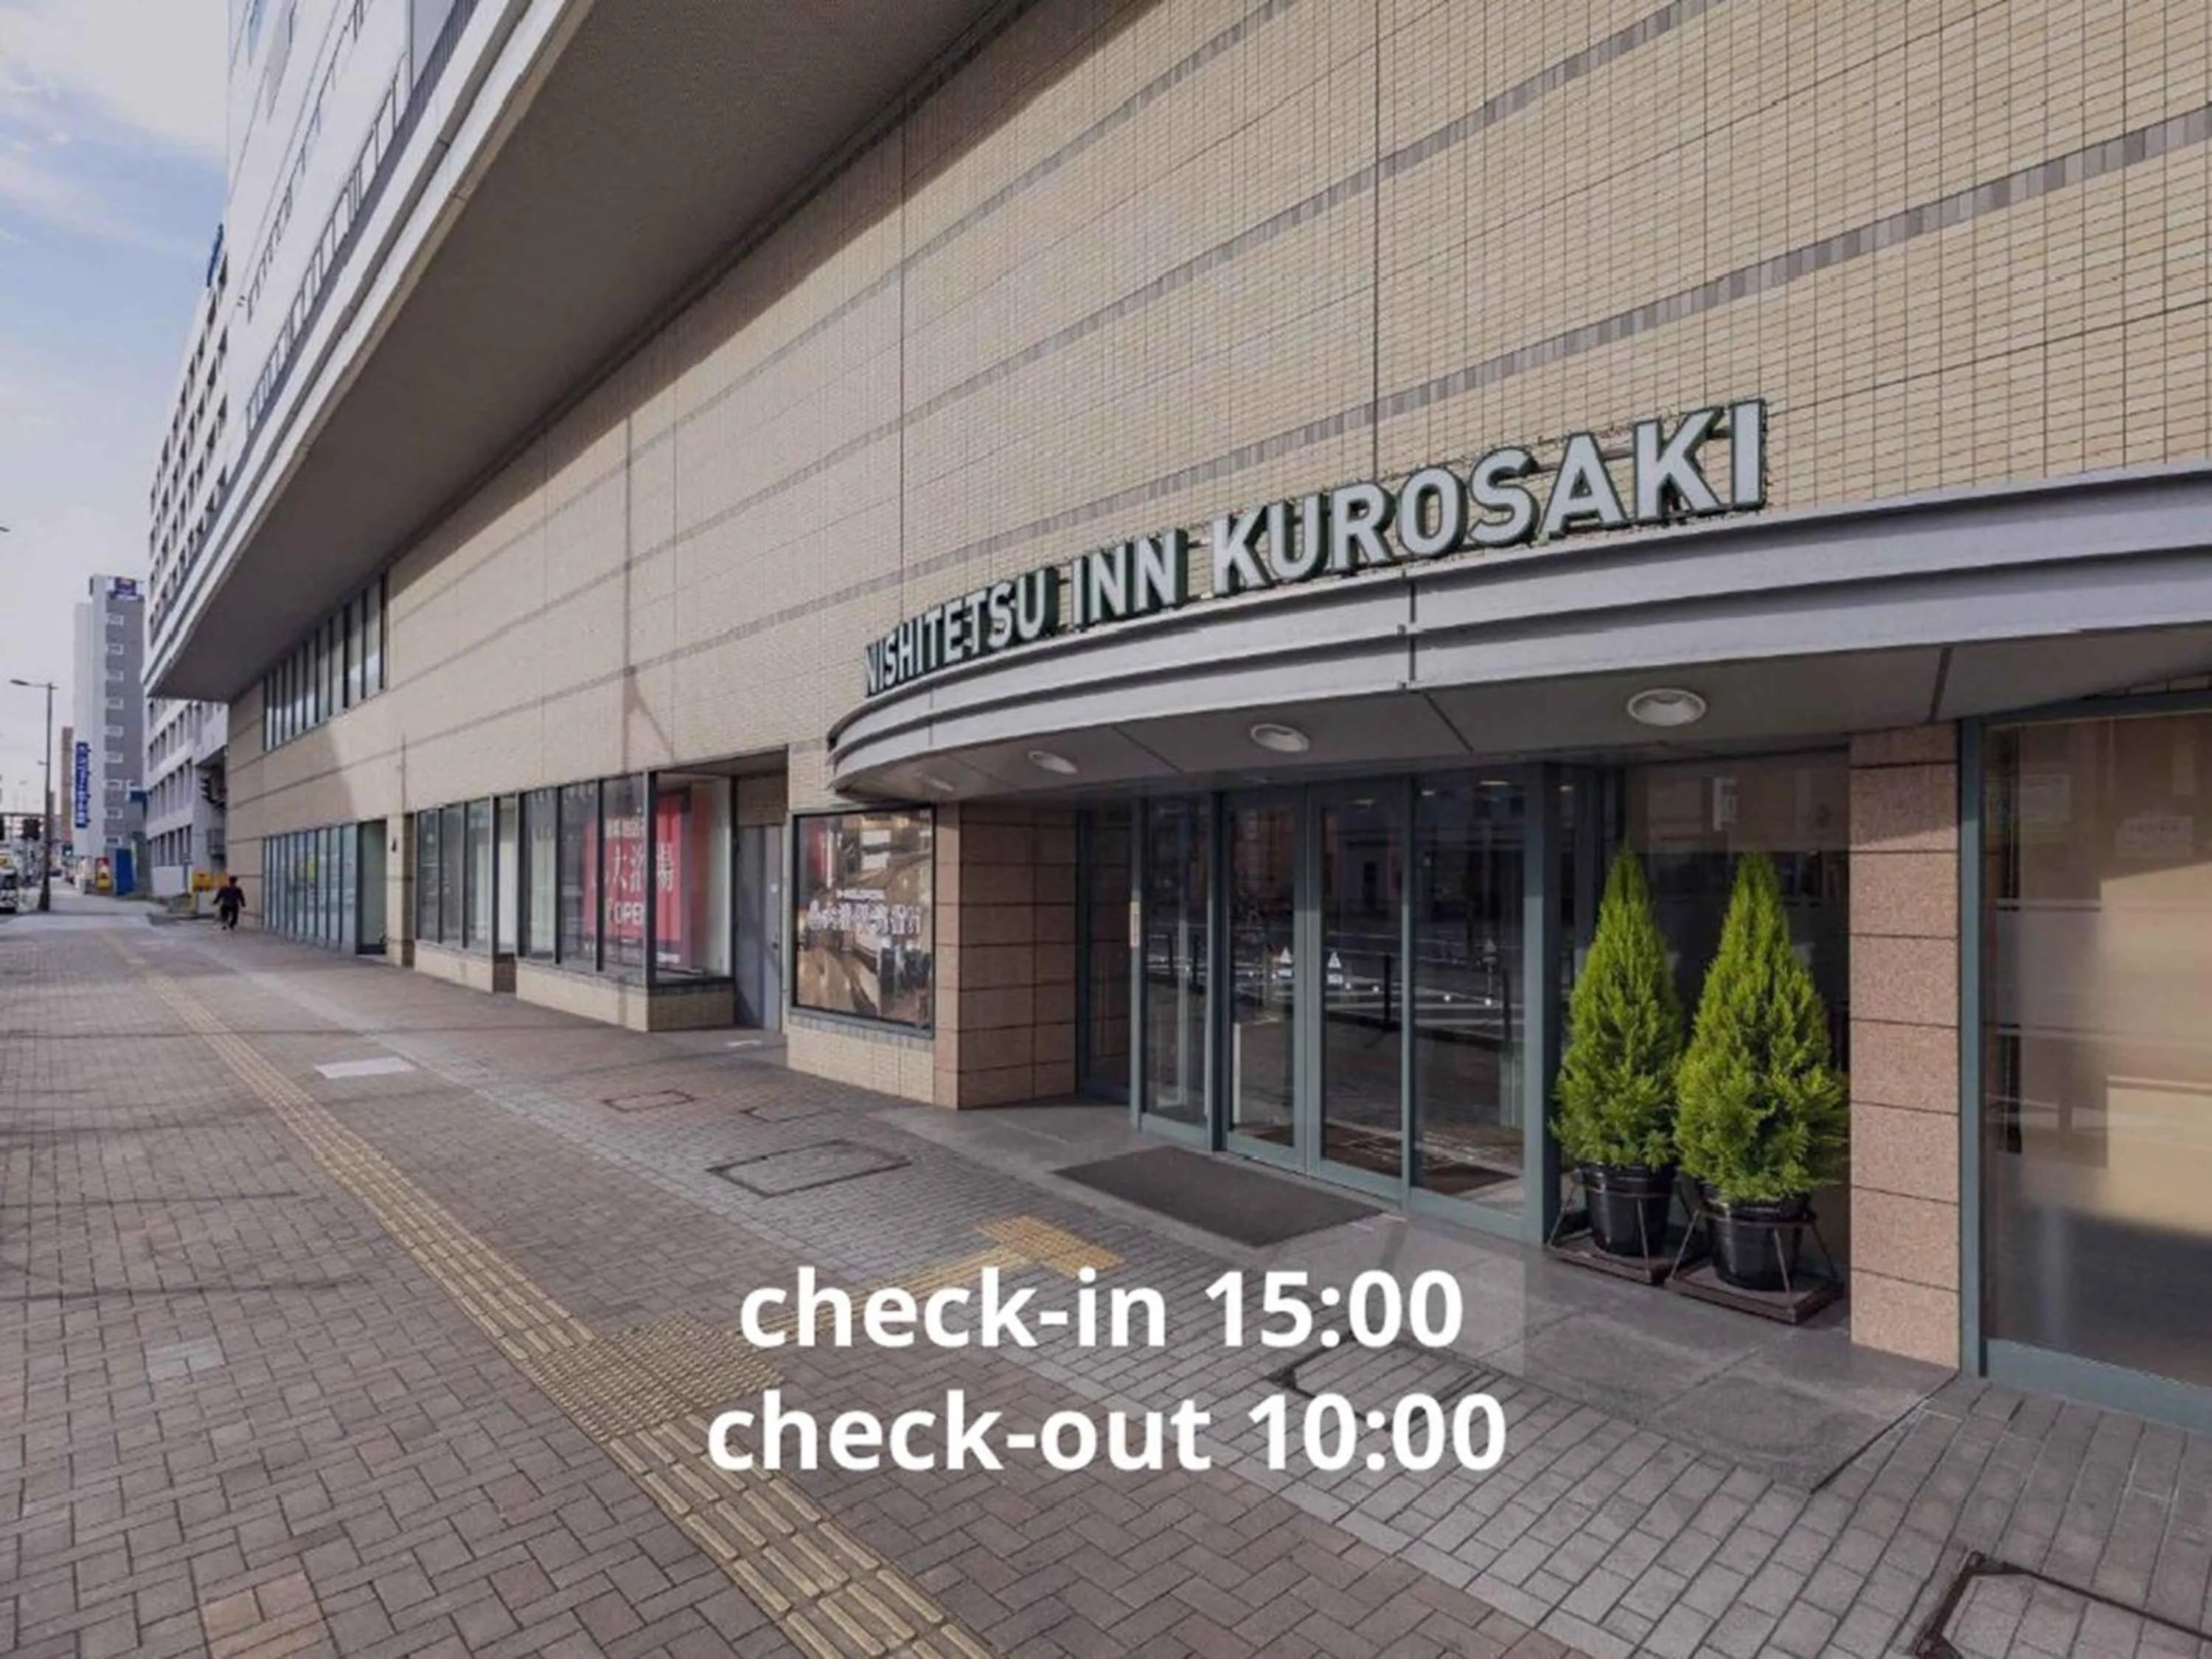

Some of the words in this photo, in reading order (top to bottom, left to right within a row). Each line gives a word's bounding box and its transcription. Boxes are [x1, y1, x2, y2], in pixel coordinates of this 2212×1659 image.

[864, 567, 1053, 697] NISHITETSU
[1071, 528, 1186, 627] INN
[1211, 398, 1767, 594] KUROSAKI
